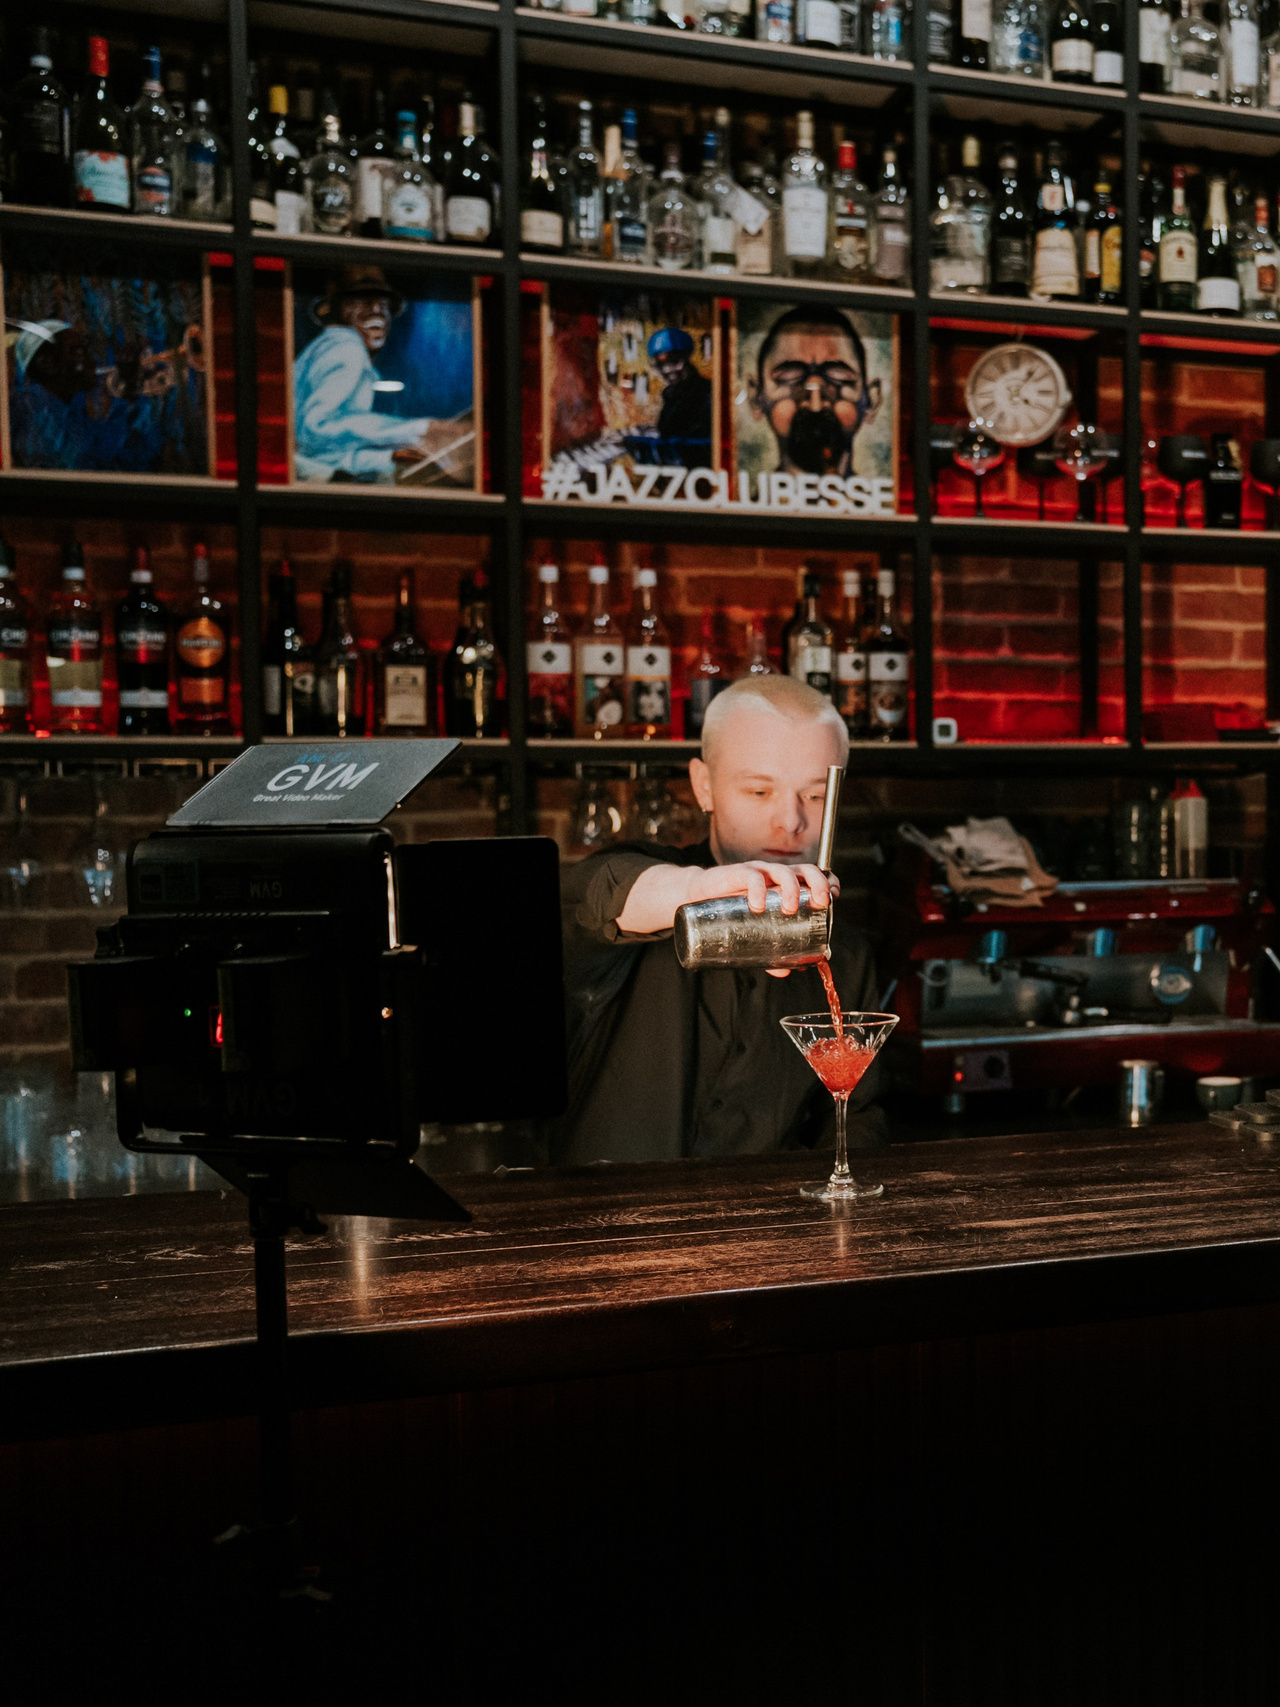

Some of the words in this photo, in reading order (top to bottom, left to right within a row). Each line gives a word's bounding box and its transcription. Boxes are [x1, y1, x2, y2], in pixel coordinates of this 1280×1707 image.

[541, 464, 895, 515] #JAZZCLUBESSE
[267, 762, 380, 791] GVM
[253, 794, 282, 802] Great
[283, 794, 310, 802] Video
[311, 793, 345, 801] Maker
